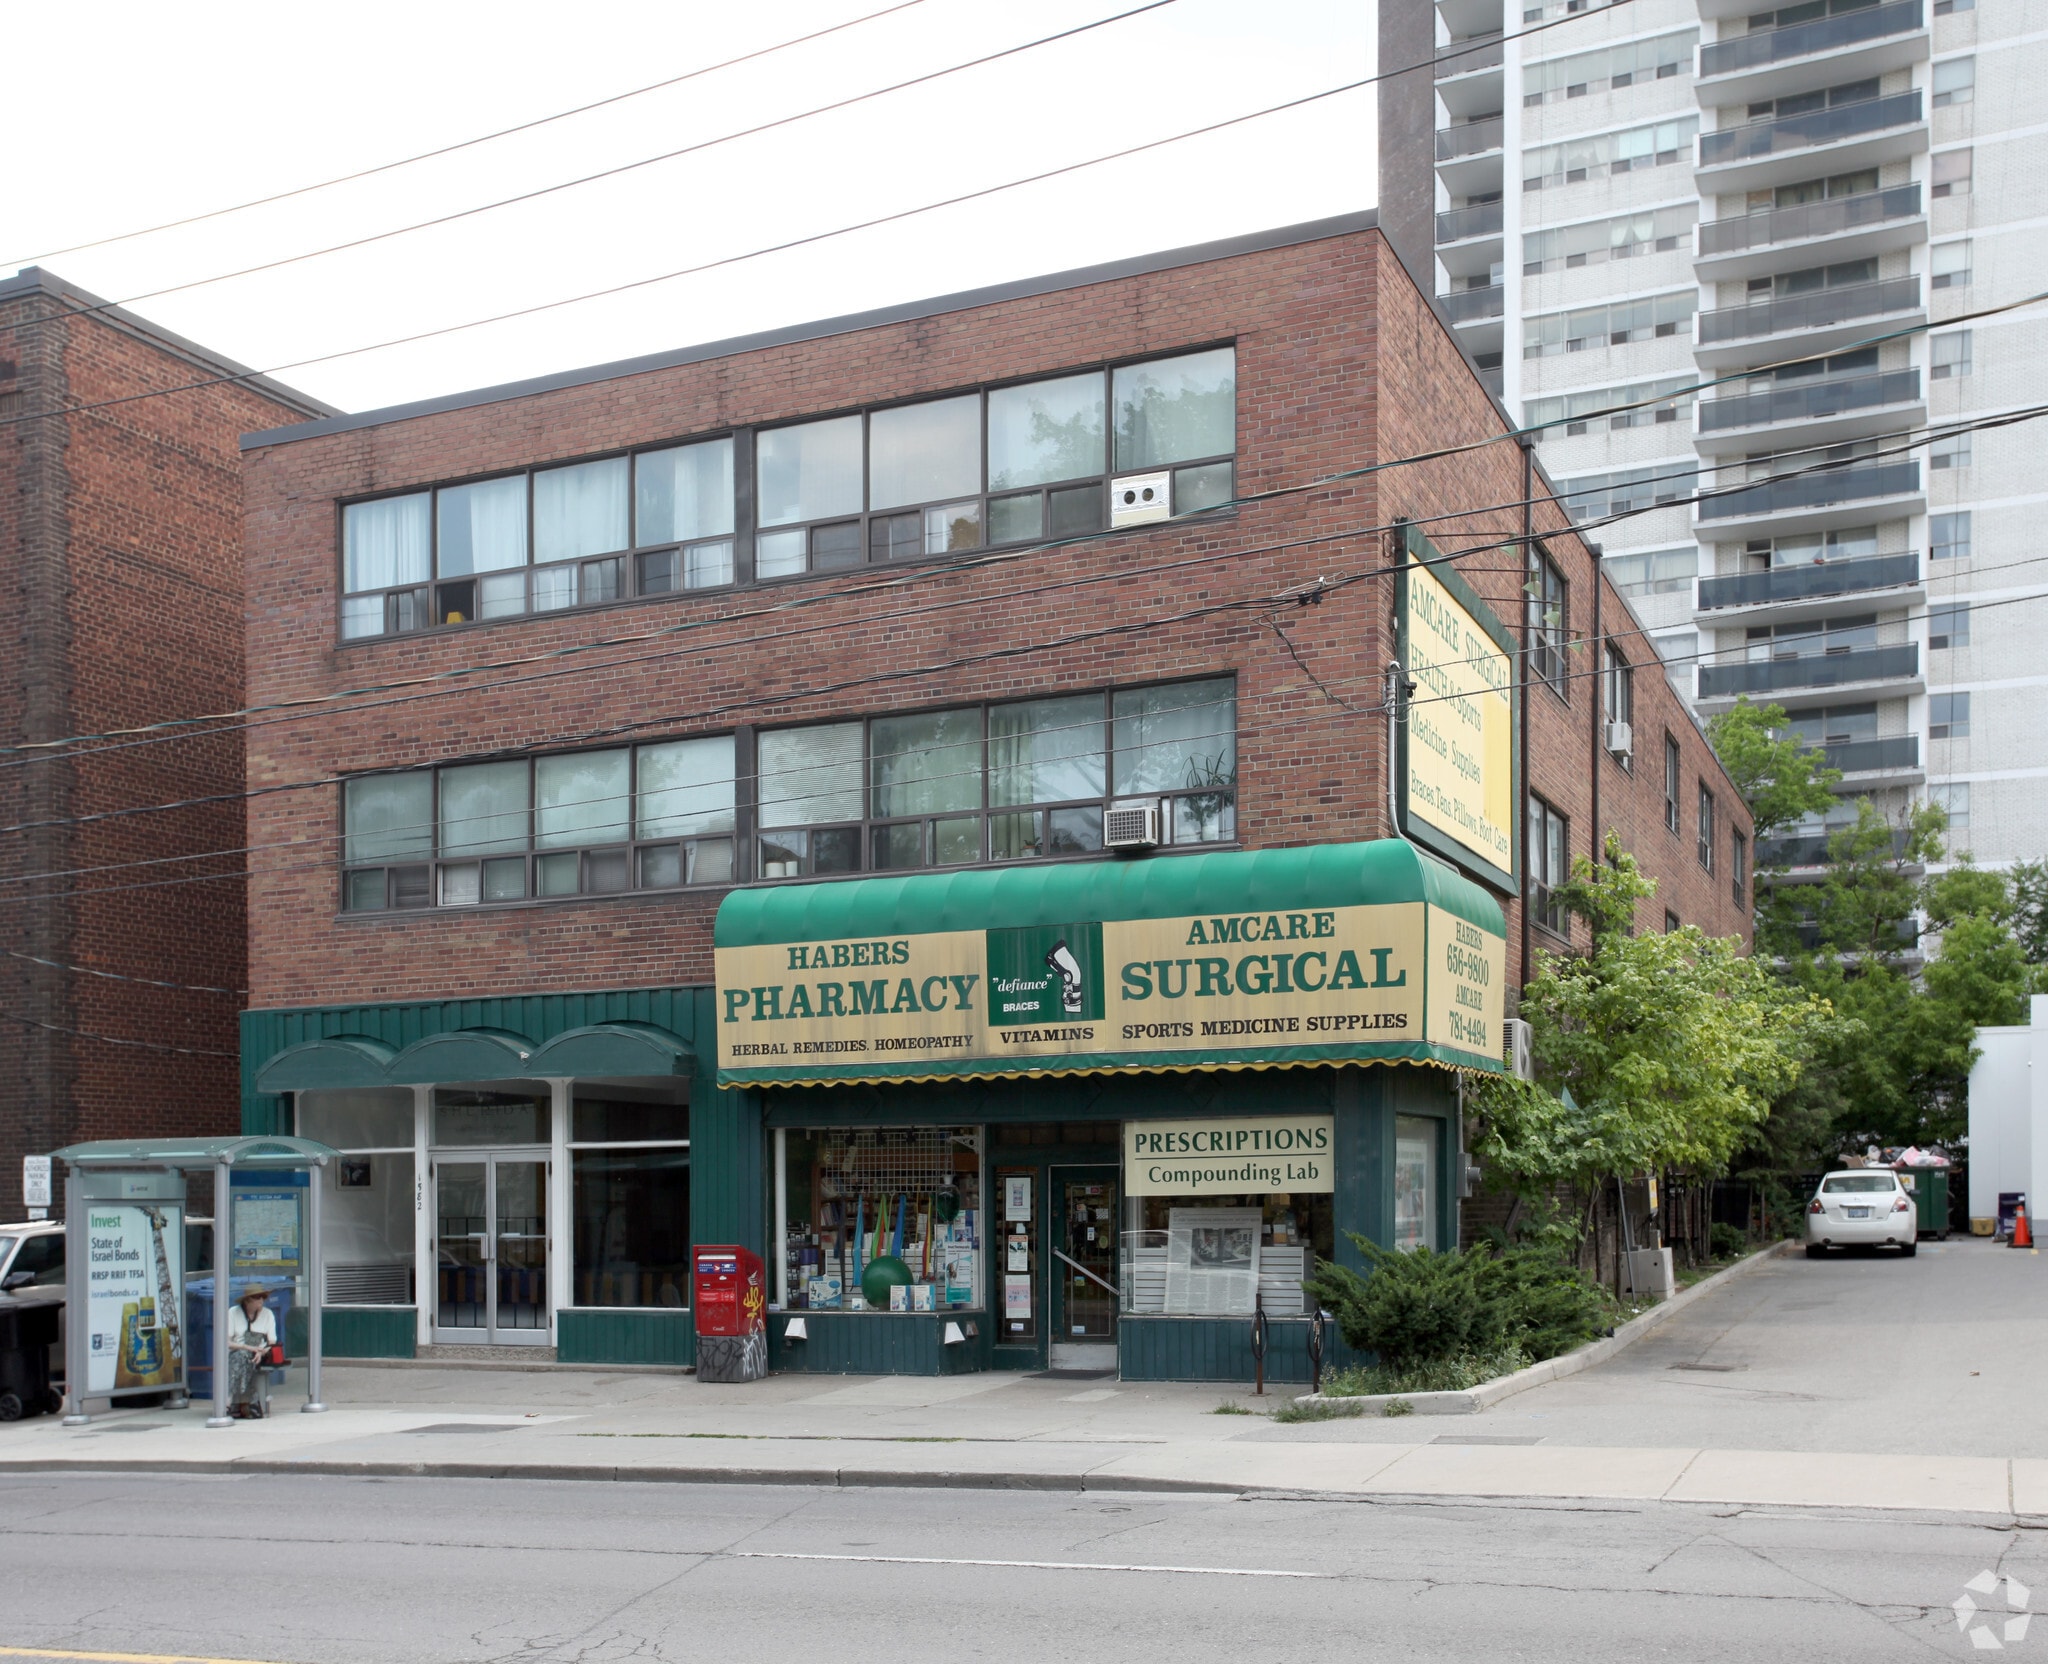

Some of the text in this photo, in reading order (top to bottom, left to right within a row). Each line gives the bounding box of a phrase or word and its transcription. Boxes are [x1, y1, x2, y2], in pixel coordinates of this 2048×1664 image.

[1411, 578, 1508, 702] AMCARE SURGICAL
[1411, 643, 1481, 731] HEALTH & Sports
[1411, 711, 1480, 784] Medicine Supplies
[1480, 816, 1492, 844] Foot
[1494, 826, 1508, 854] Care
[1186, 912, 1335, 945] AMCARE
[1456, 921, 1482, 951] HABERS
[787, 941, 909, 970] HABERS
[1447, 943, 1489, 987] 656-9800
[1122, 948, 1406, 1000] SURGICAL
[724, 974, 979, 1022] PHARMACY
[1003, 1001, 1039, 1012] BRACES
[1455, 982, 1482, 1011] AMCARE
[1000, 1027, 1094, 1043] VITAMINS
[1122, 1014, 1408, 1039] SPORTS MEDICINE SUPPLIES
[1448, 1011, 1486, 1047] 781-4494
[732, 1043, 788, 1056] HERBAL
[874, 1035, 973, 1050] HOMEOPATHY
[1135, 1127, 1327, 1153] PRESCRIPTIONS
[1149, 1162, 1318, 1187] Compounding Lab
[92, 1214, 121, 1228] Invest
[92, 1236, 122, 1248] State of
[92, 1249, 139, 1262] Israel Bonds
[92, 1270, 144, 1280] RRSP RRIF TFSA
[92, 1288, 139, 1298] israelbonds.ca
